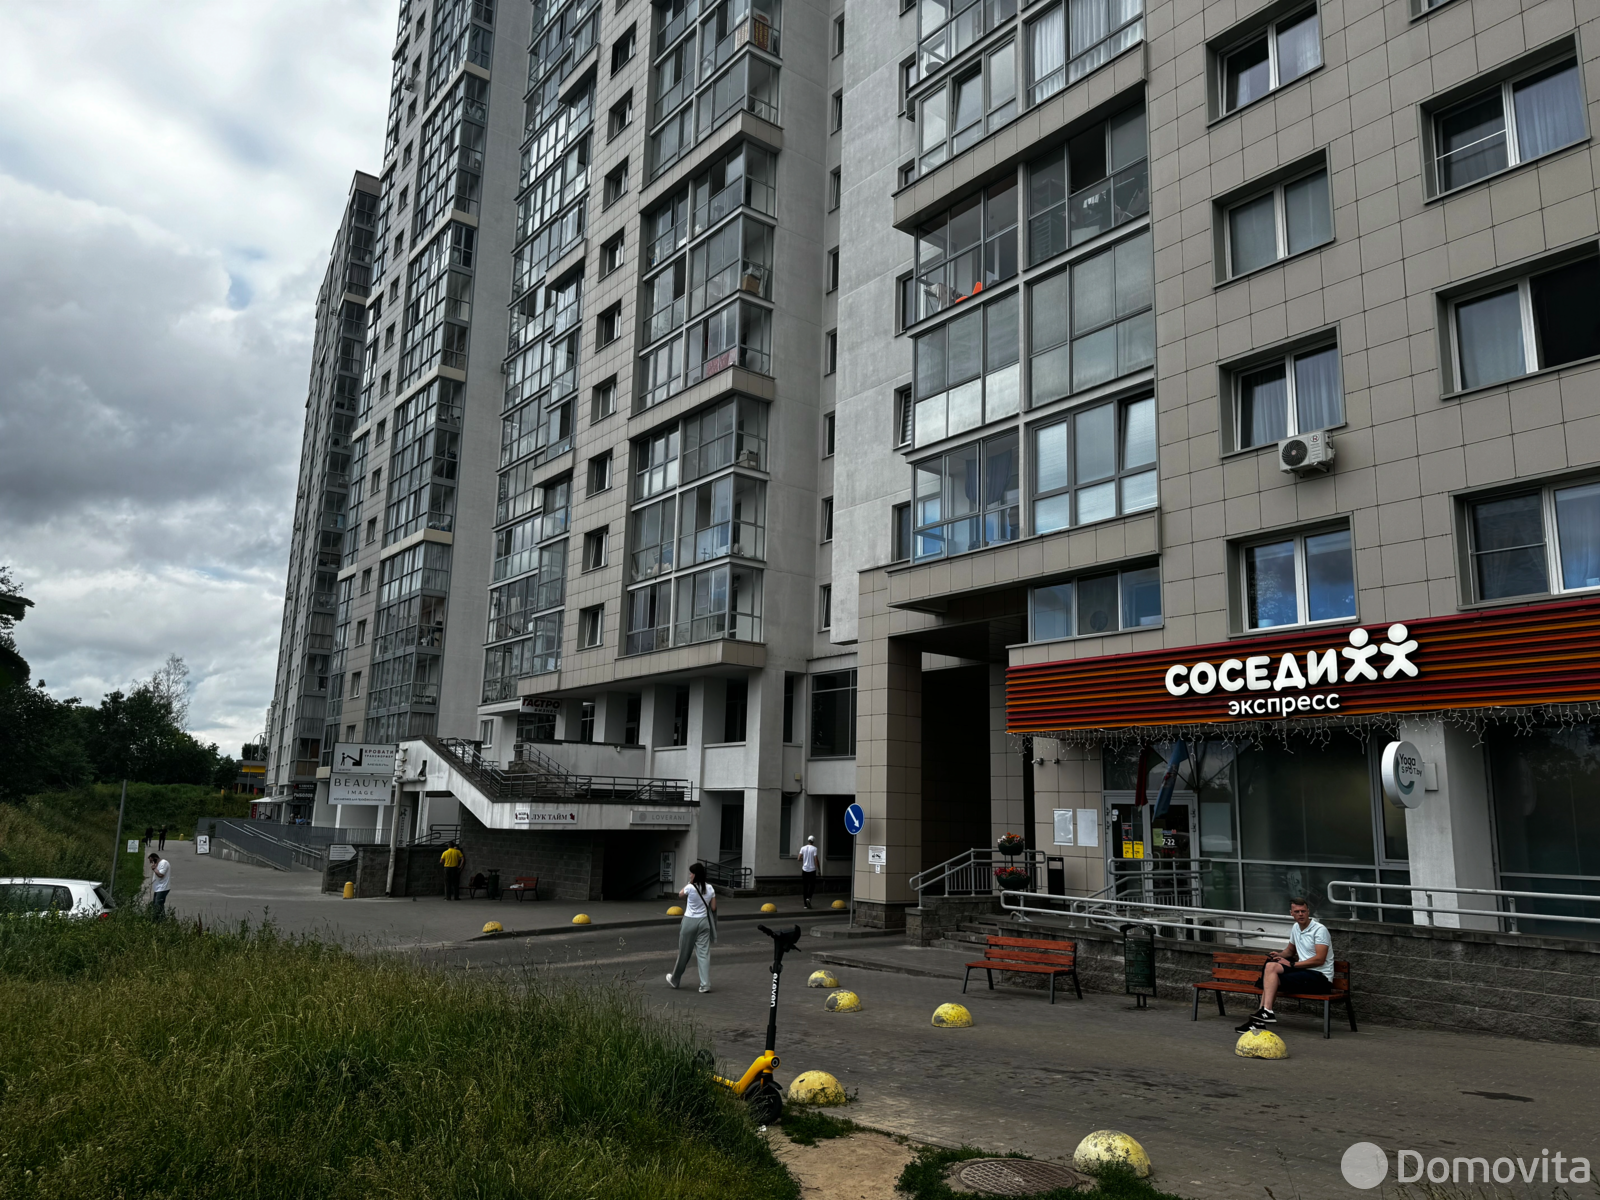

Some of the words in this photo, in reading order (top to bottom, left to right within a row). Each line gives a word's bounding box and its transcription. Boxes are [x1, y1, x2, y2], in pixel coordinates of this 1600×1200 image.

[1165, 648, 1339, 697] СОСЕДИ
[522, 698, 560, 709] ГАСТРО
[1227, 692, 1341, 718] экспресс
[1399, 753, 1416, 769] Yoga
[334, 778, 389, 788] BEAUTY
[547, 812, 568, 821] ТАЙМ
